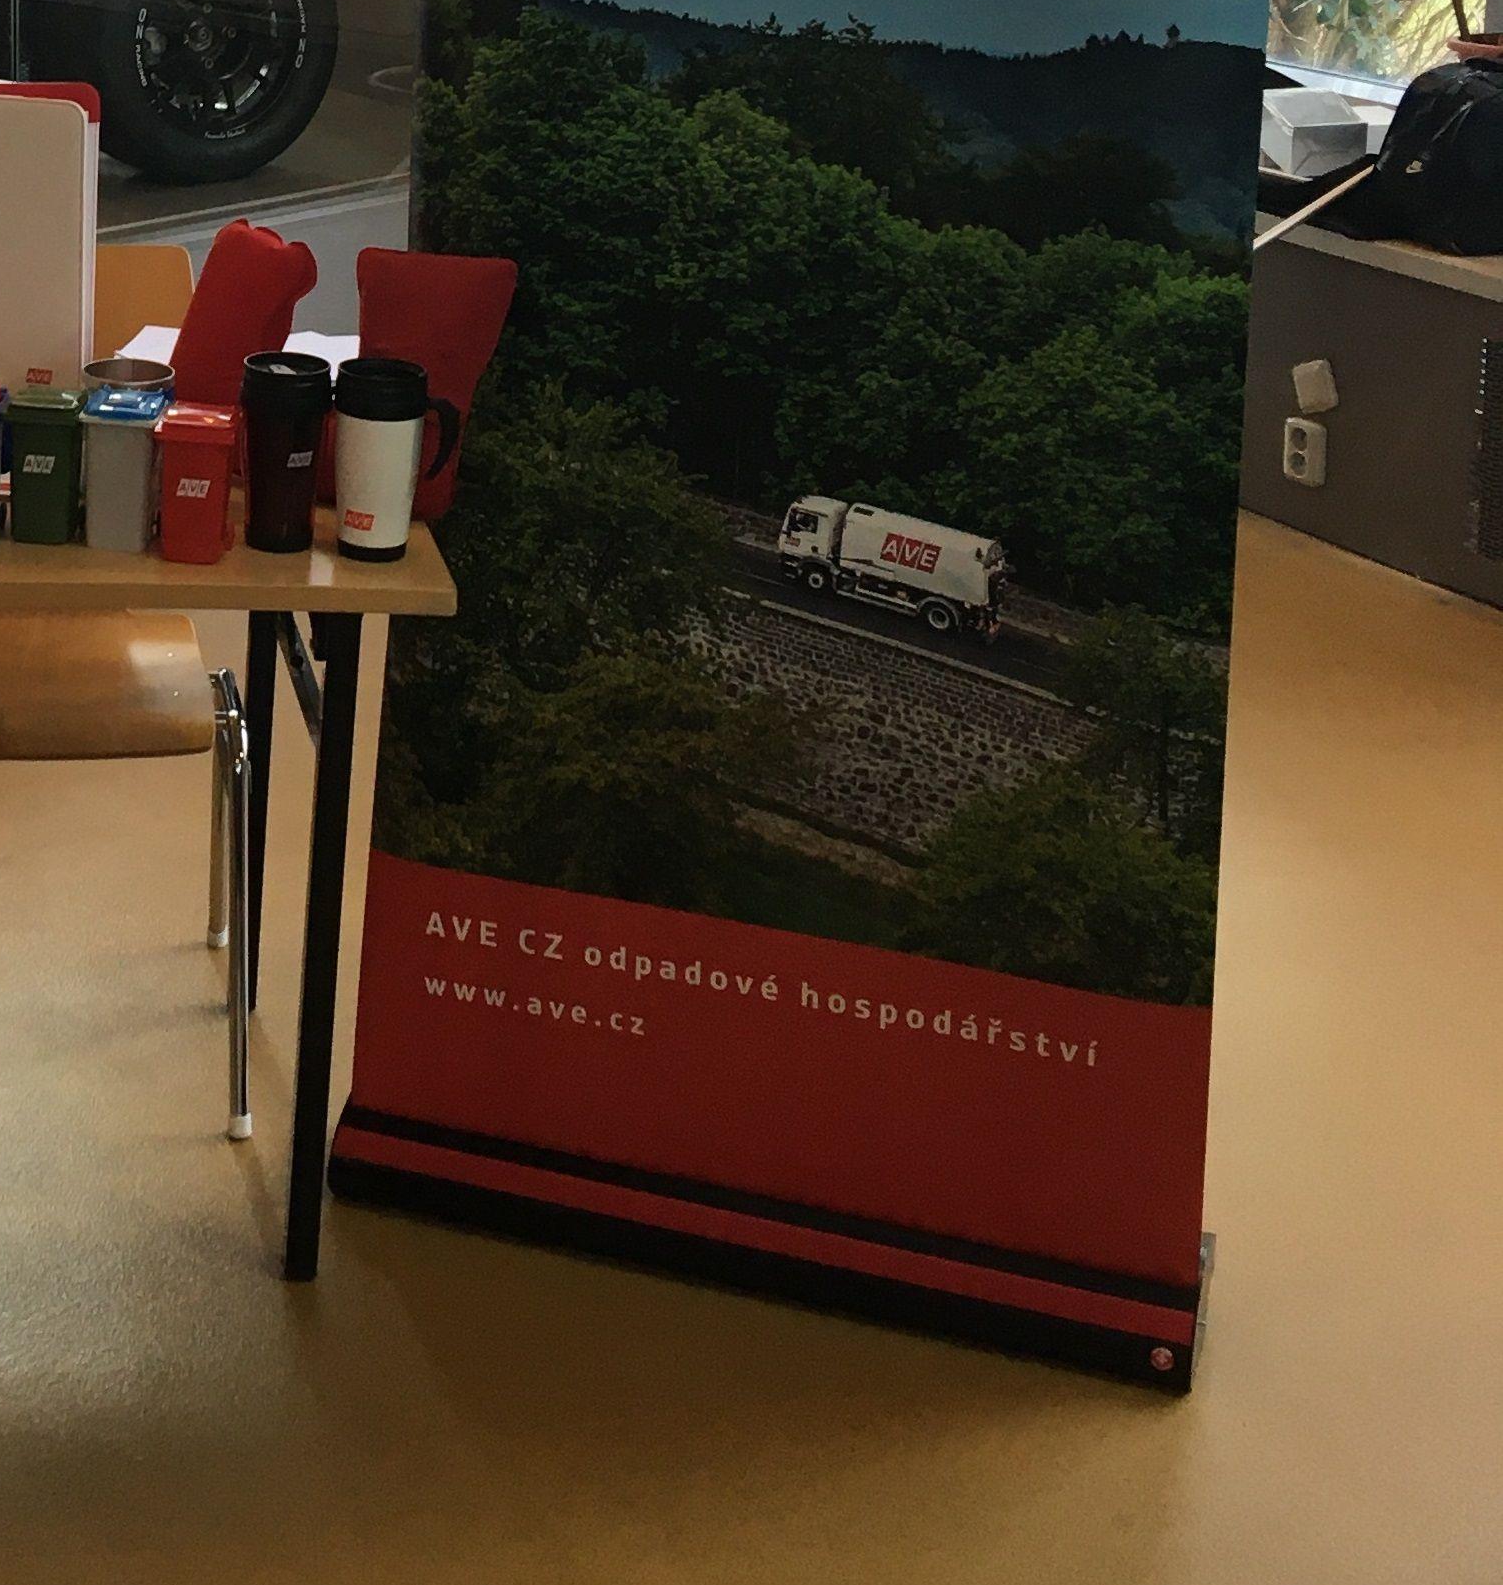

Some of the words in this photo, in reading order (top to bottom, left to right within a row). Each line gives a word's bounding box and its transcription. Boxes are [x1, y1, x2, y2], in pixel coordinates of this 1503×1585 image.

[177, 479, 210, 497] AVE
[882, 538, 939, 570] AVE
[424, 910, 499, 950] AVE
[517, 929, 565, 961] CZ
[583, 942, 780, 1003] odpadové
[799, 980, 1101, 1069] hospodářství
[424, 975, 648, 1037] www.ave.cz
